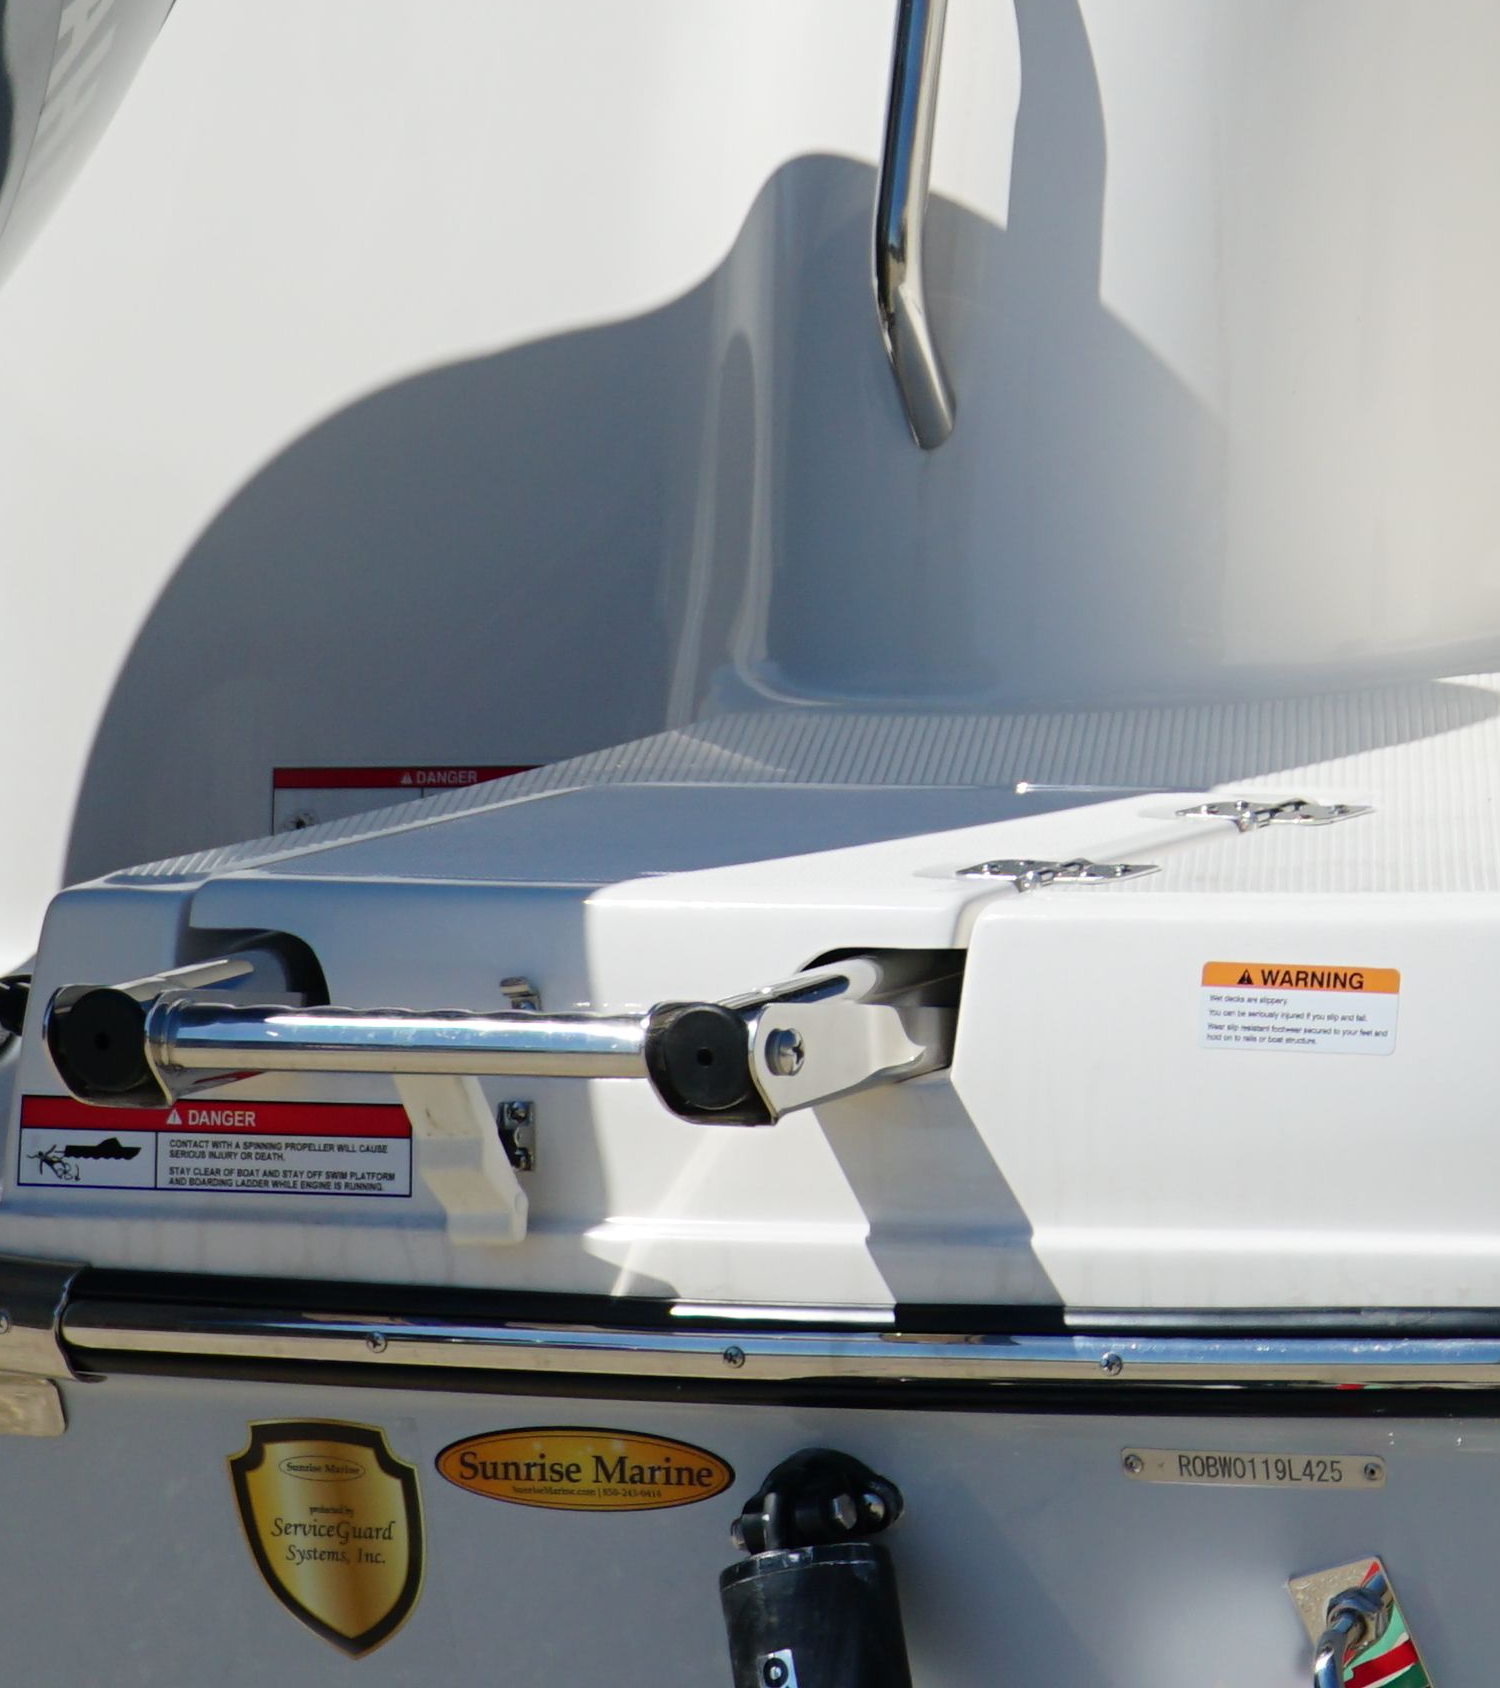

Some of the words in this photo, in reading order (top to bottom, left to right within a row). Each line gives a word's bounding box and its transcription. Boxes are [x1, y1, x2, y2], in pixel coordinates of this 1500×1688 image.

[416, 770, 477, 784] DANGER
[1261, 969, 1364, 990] WARNING
[188, 1110, 256, 1127] DANGER
[169, 1139, 209, 1148] CONTACT
[212, 1141, 232, 1149] WITH
[235, 1141, 240, 1149] A
[243, 1141, 282, 1150] SPINNING
[284, 1143, 334, 1152] PROPELLER
[337, 1144, 356, 1152] WILL
[359, 1144, 388, 1153] CAUSE
[169, 1149, 206, 1159] SERIOUS
[208, 1151, 238, 1160] INJURY
[240, 1151, 252, 1160] OR
[254, 1152, 285, 1161] DEATH.
[169, 1166, 191, 1175] STAY
[193, 1167, 221, 1176] CLEAR
[223, 1168, 236, 1177] OF
[237, 1168, 260, 1177] BOAT
[263, 1169, 280, 1178] AND
[282, 1170, 304, 1178] STAY
[307, 1170, 322, 1179] OFF
[325, 1171, 347, 1179] SWIM
[350, 1171, 395, 1181] PLATFORM
[169, 1177, 187, 1186] AND
[189, 1178, 233, 1187] BOARDING
[235, 1179, 269, 1188] LADDER
[270, 1180, 298, 1189] WHILE
[300, 1181, 331, 1190] ENGINE
[334, 1181, 341, 1190] IS
[286, 1462, 322, 1472] Sunrise
[325, 1464, 360, 1475] Marine
[458, 1451, 581, 1483] Sunrise
[592, 1454, 714, 1488] Marine
[271, 1517, 396, 1545] ServiceGuard
[357, 1548, 386, 1564] Inc.
